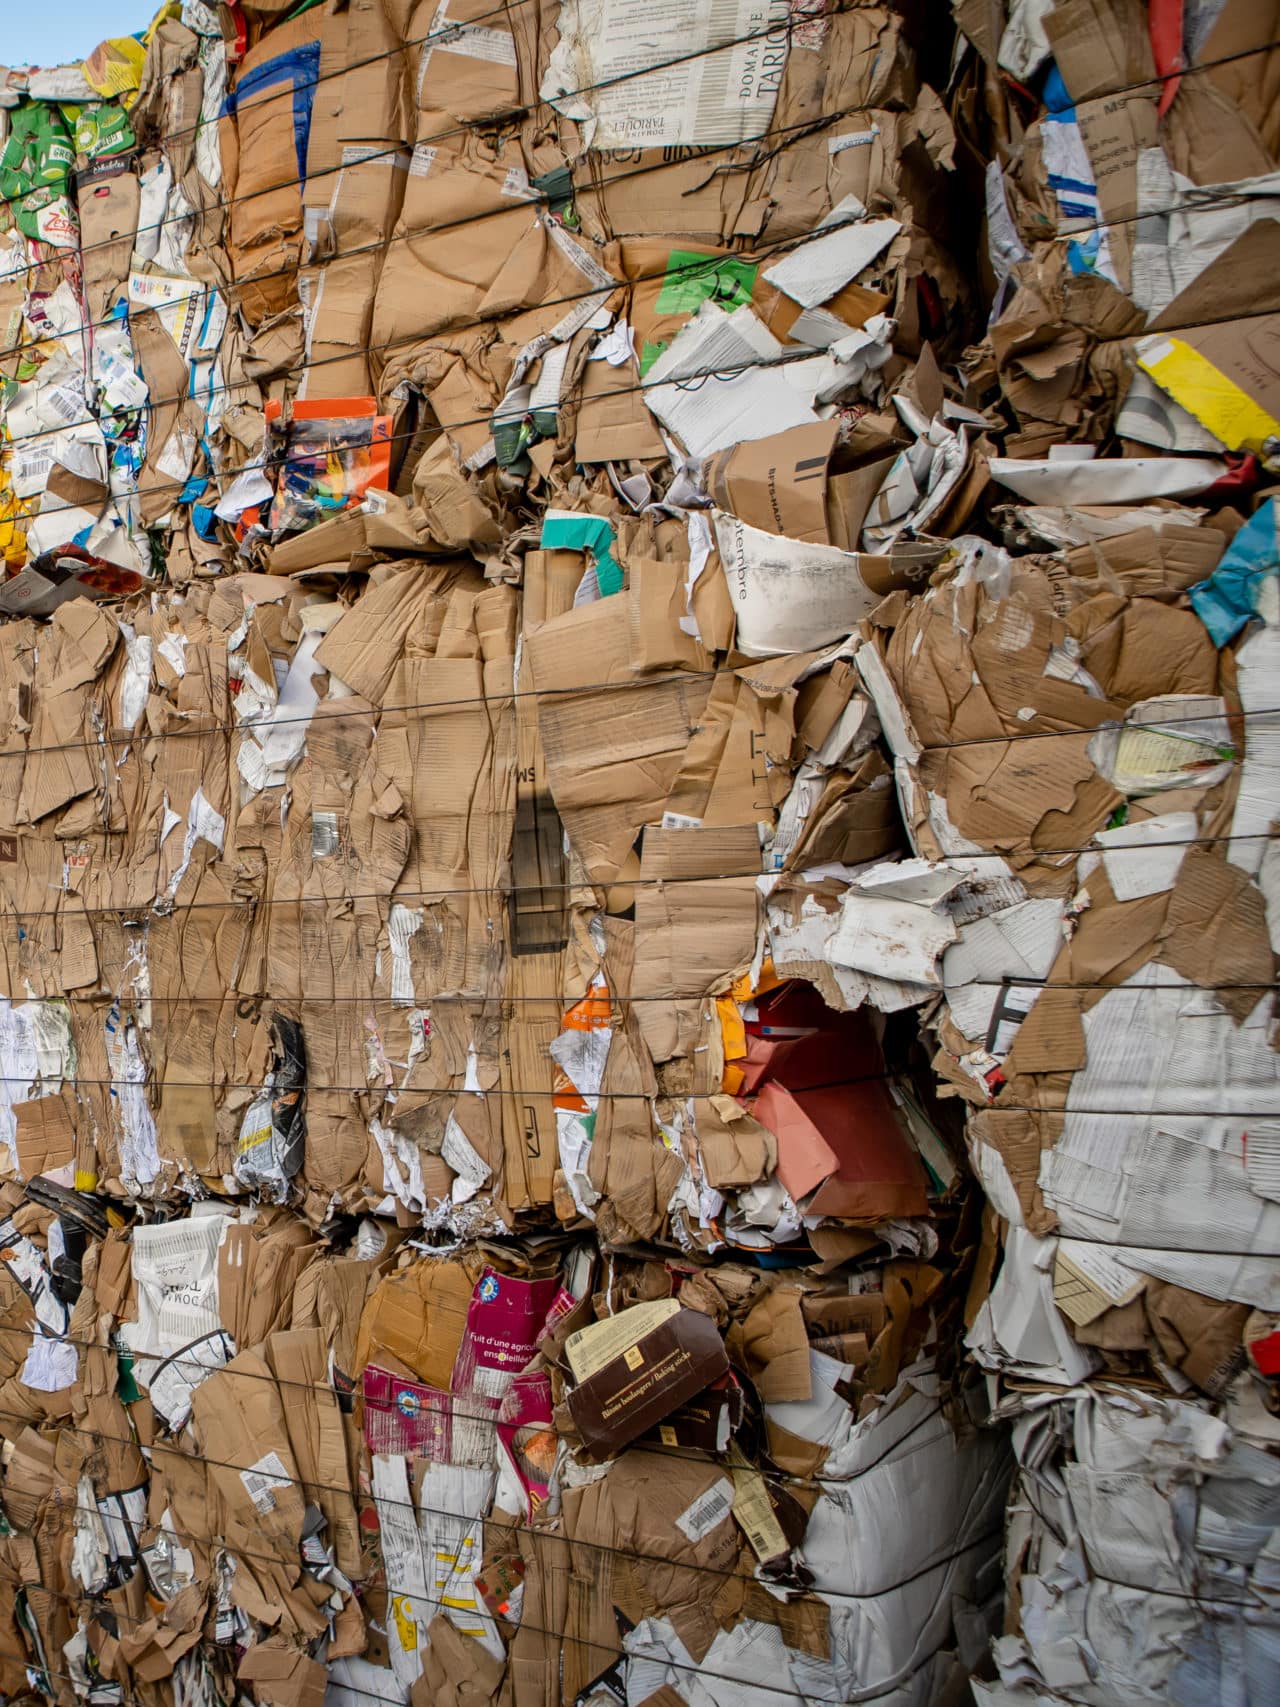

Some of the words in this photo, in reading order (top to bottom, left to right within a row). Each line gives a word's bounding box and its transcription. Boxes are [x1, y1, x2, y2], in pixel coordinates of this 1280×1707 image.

[739, 12, 763, 98] DOMAINE
[756, 0, 790, 98] TARIQU
[614, 117, 665, 133] TARIQUET
[486, 1336, 510, 1349] d'une
[655, 1364, 676, 1383] Baking
